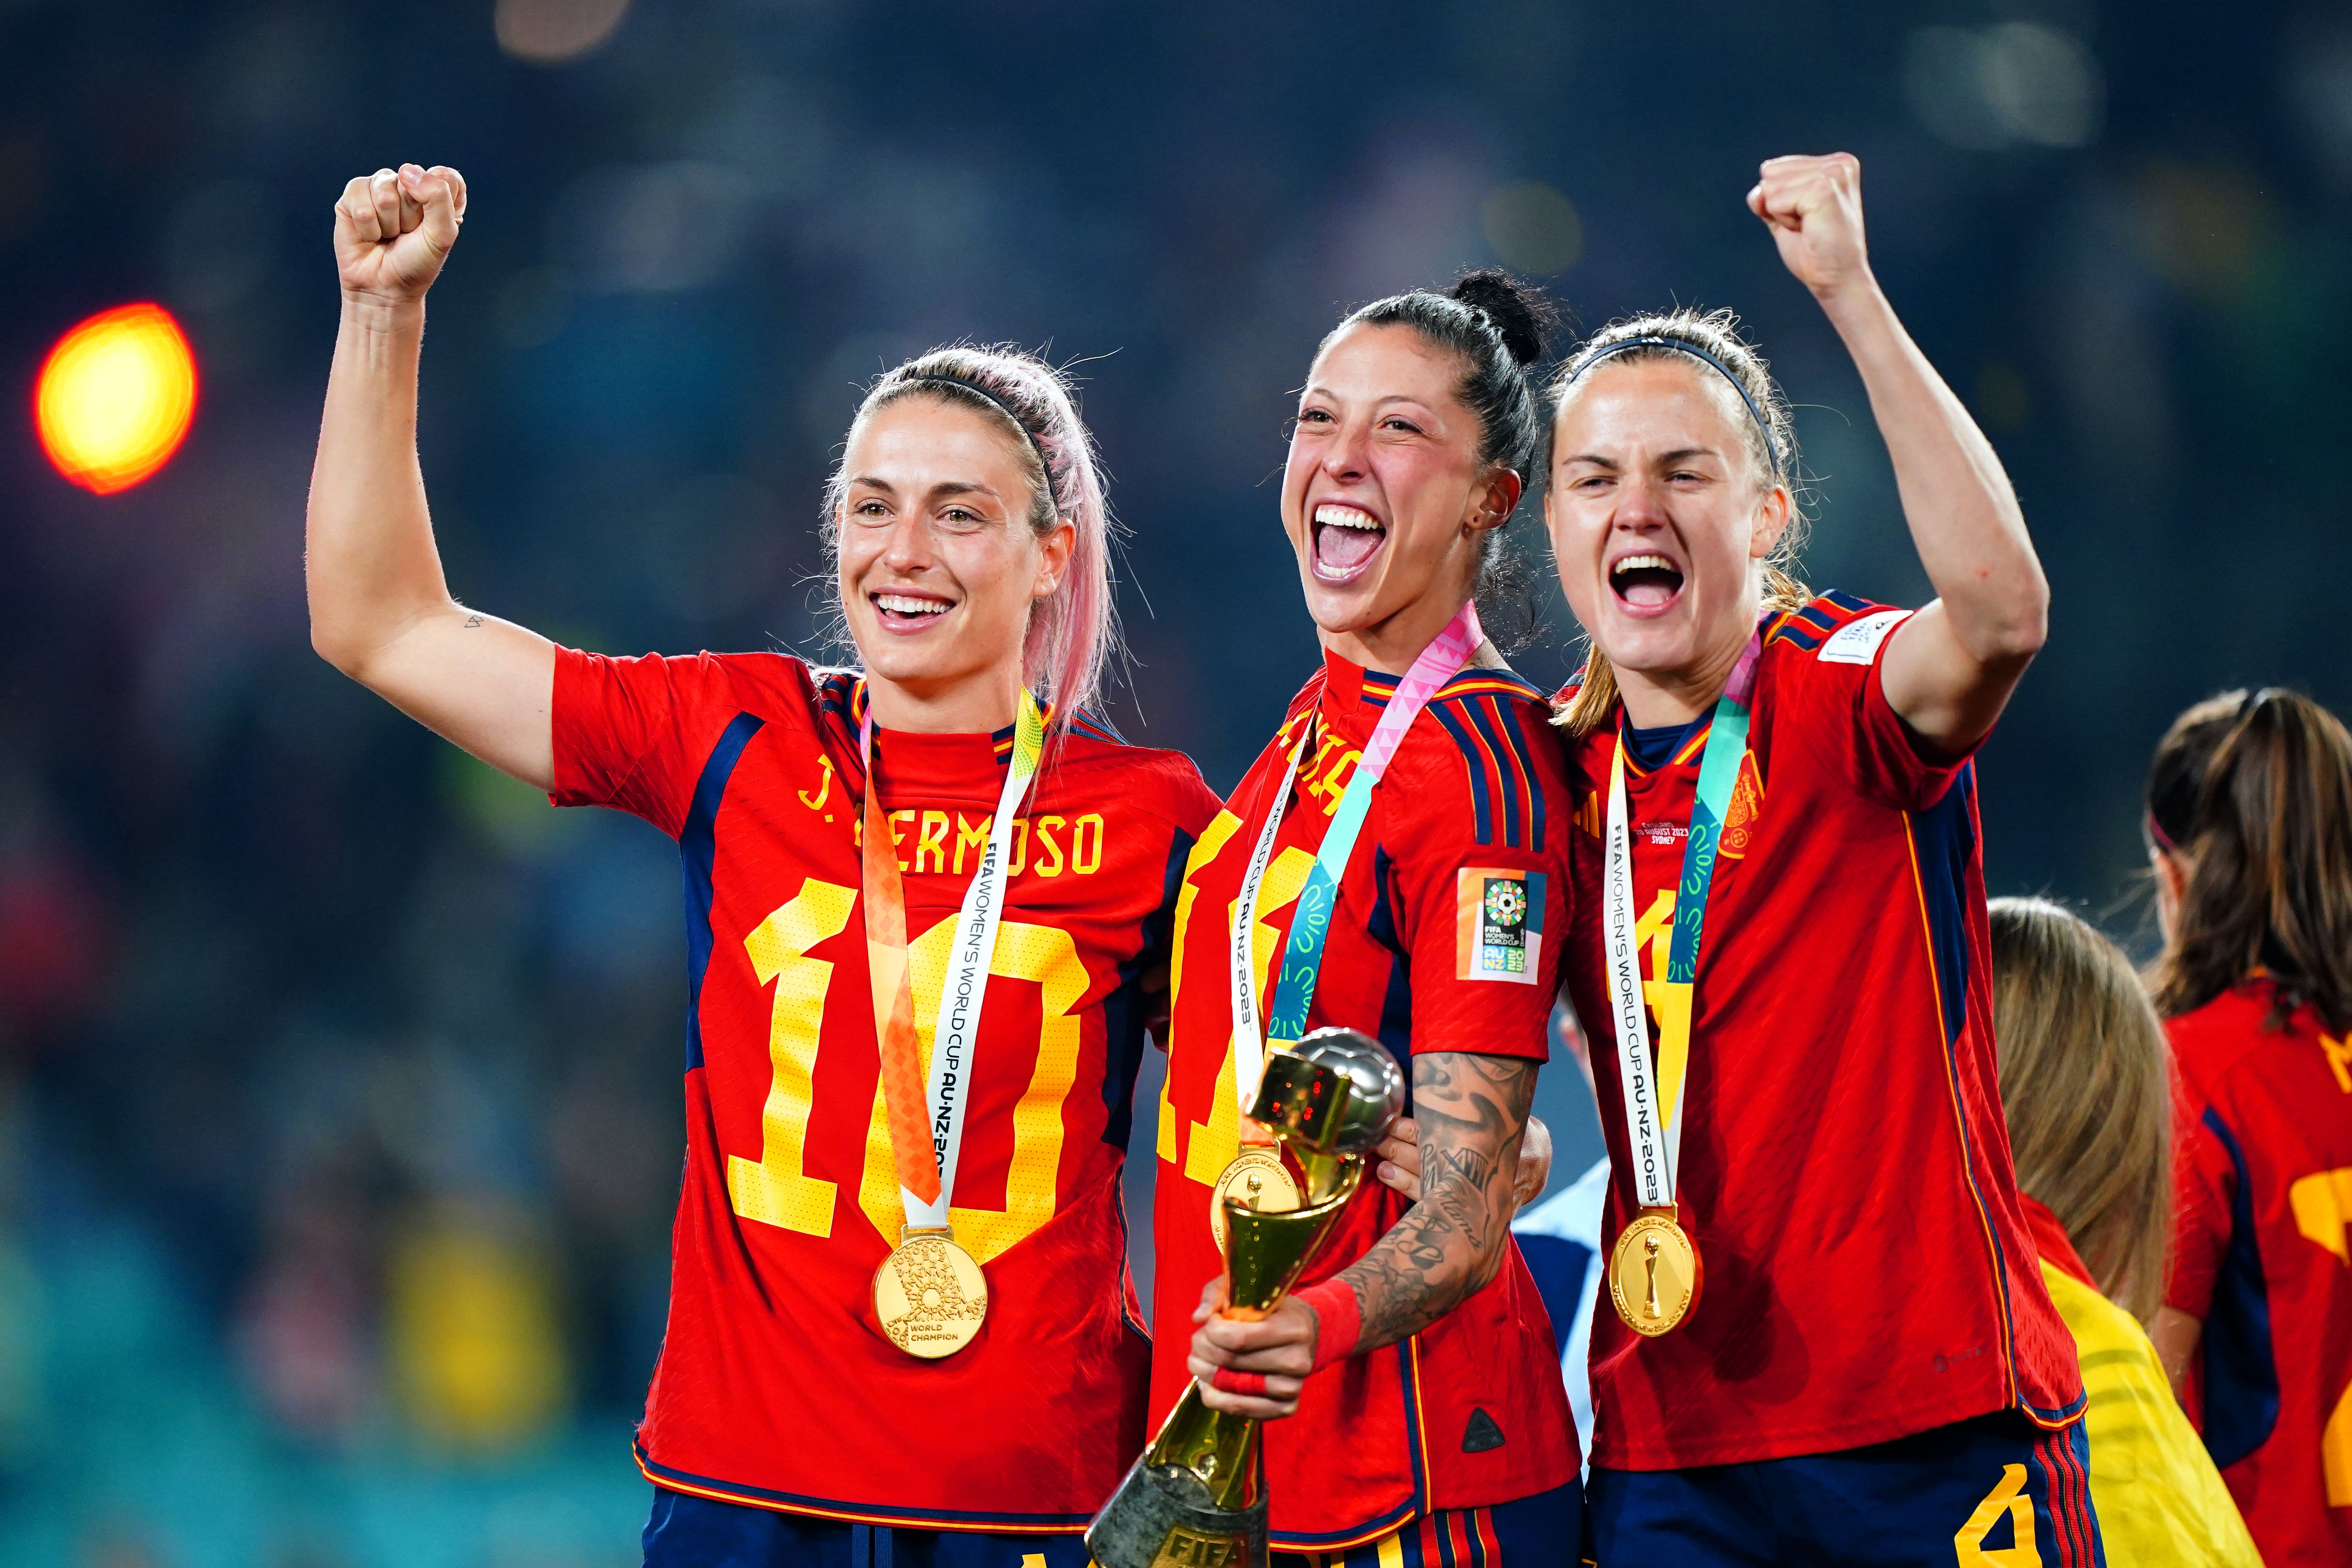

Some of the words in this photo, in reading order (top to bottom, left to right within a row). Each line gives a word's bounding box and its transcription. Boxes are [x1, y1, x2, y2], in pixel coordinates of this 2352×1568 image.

[798, 754, 835, 822] J.
[854, 808, 1103, 877] ERMOSO
[1257, 802, 1283, 863] WORLD
[1671, 828, 1689, 837] 2023
[1651, 836, 1675, 845] SYDNEY
[981, 843, 997, 879] FIFA
[1247, 866, 1260, 900] CUP
[965, 880, 993, 963] WOMEN'S
[1614, 866, 1627, 957] WOMEN'S
[1484, 948, 1505, 959] AU
[1484, 958, 1504, 970] NZ
[952, 967, 975, 1030] WORLD
[1619, 960, 1636, 1029] WORLD
[946, 1034, 962, 1070] CUP
[1628, 1033, 1642, 1070] CUP
[728, 877, 1089, 1266] 10
